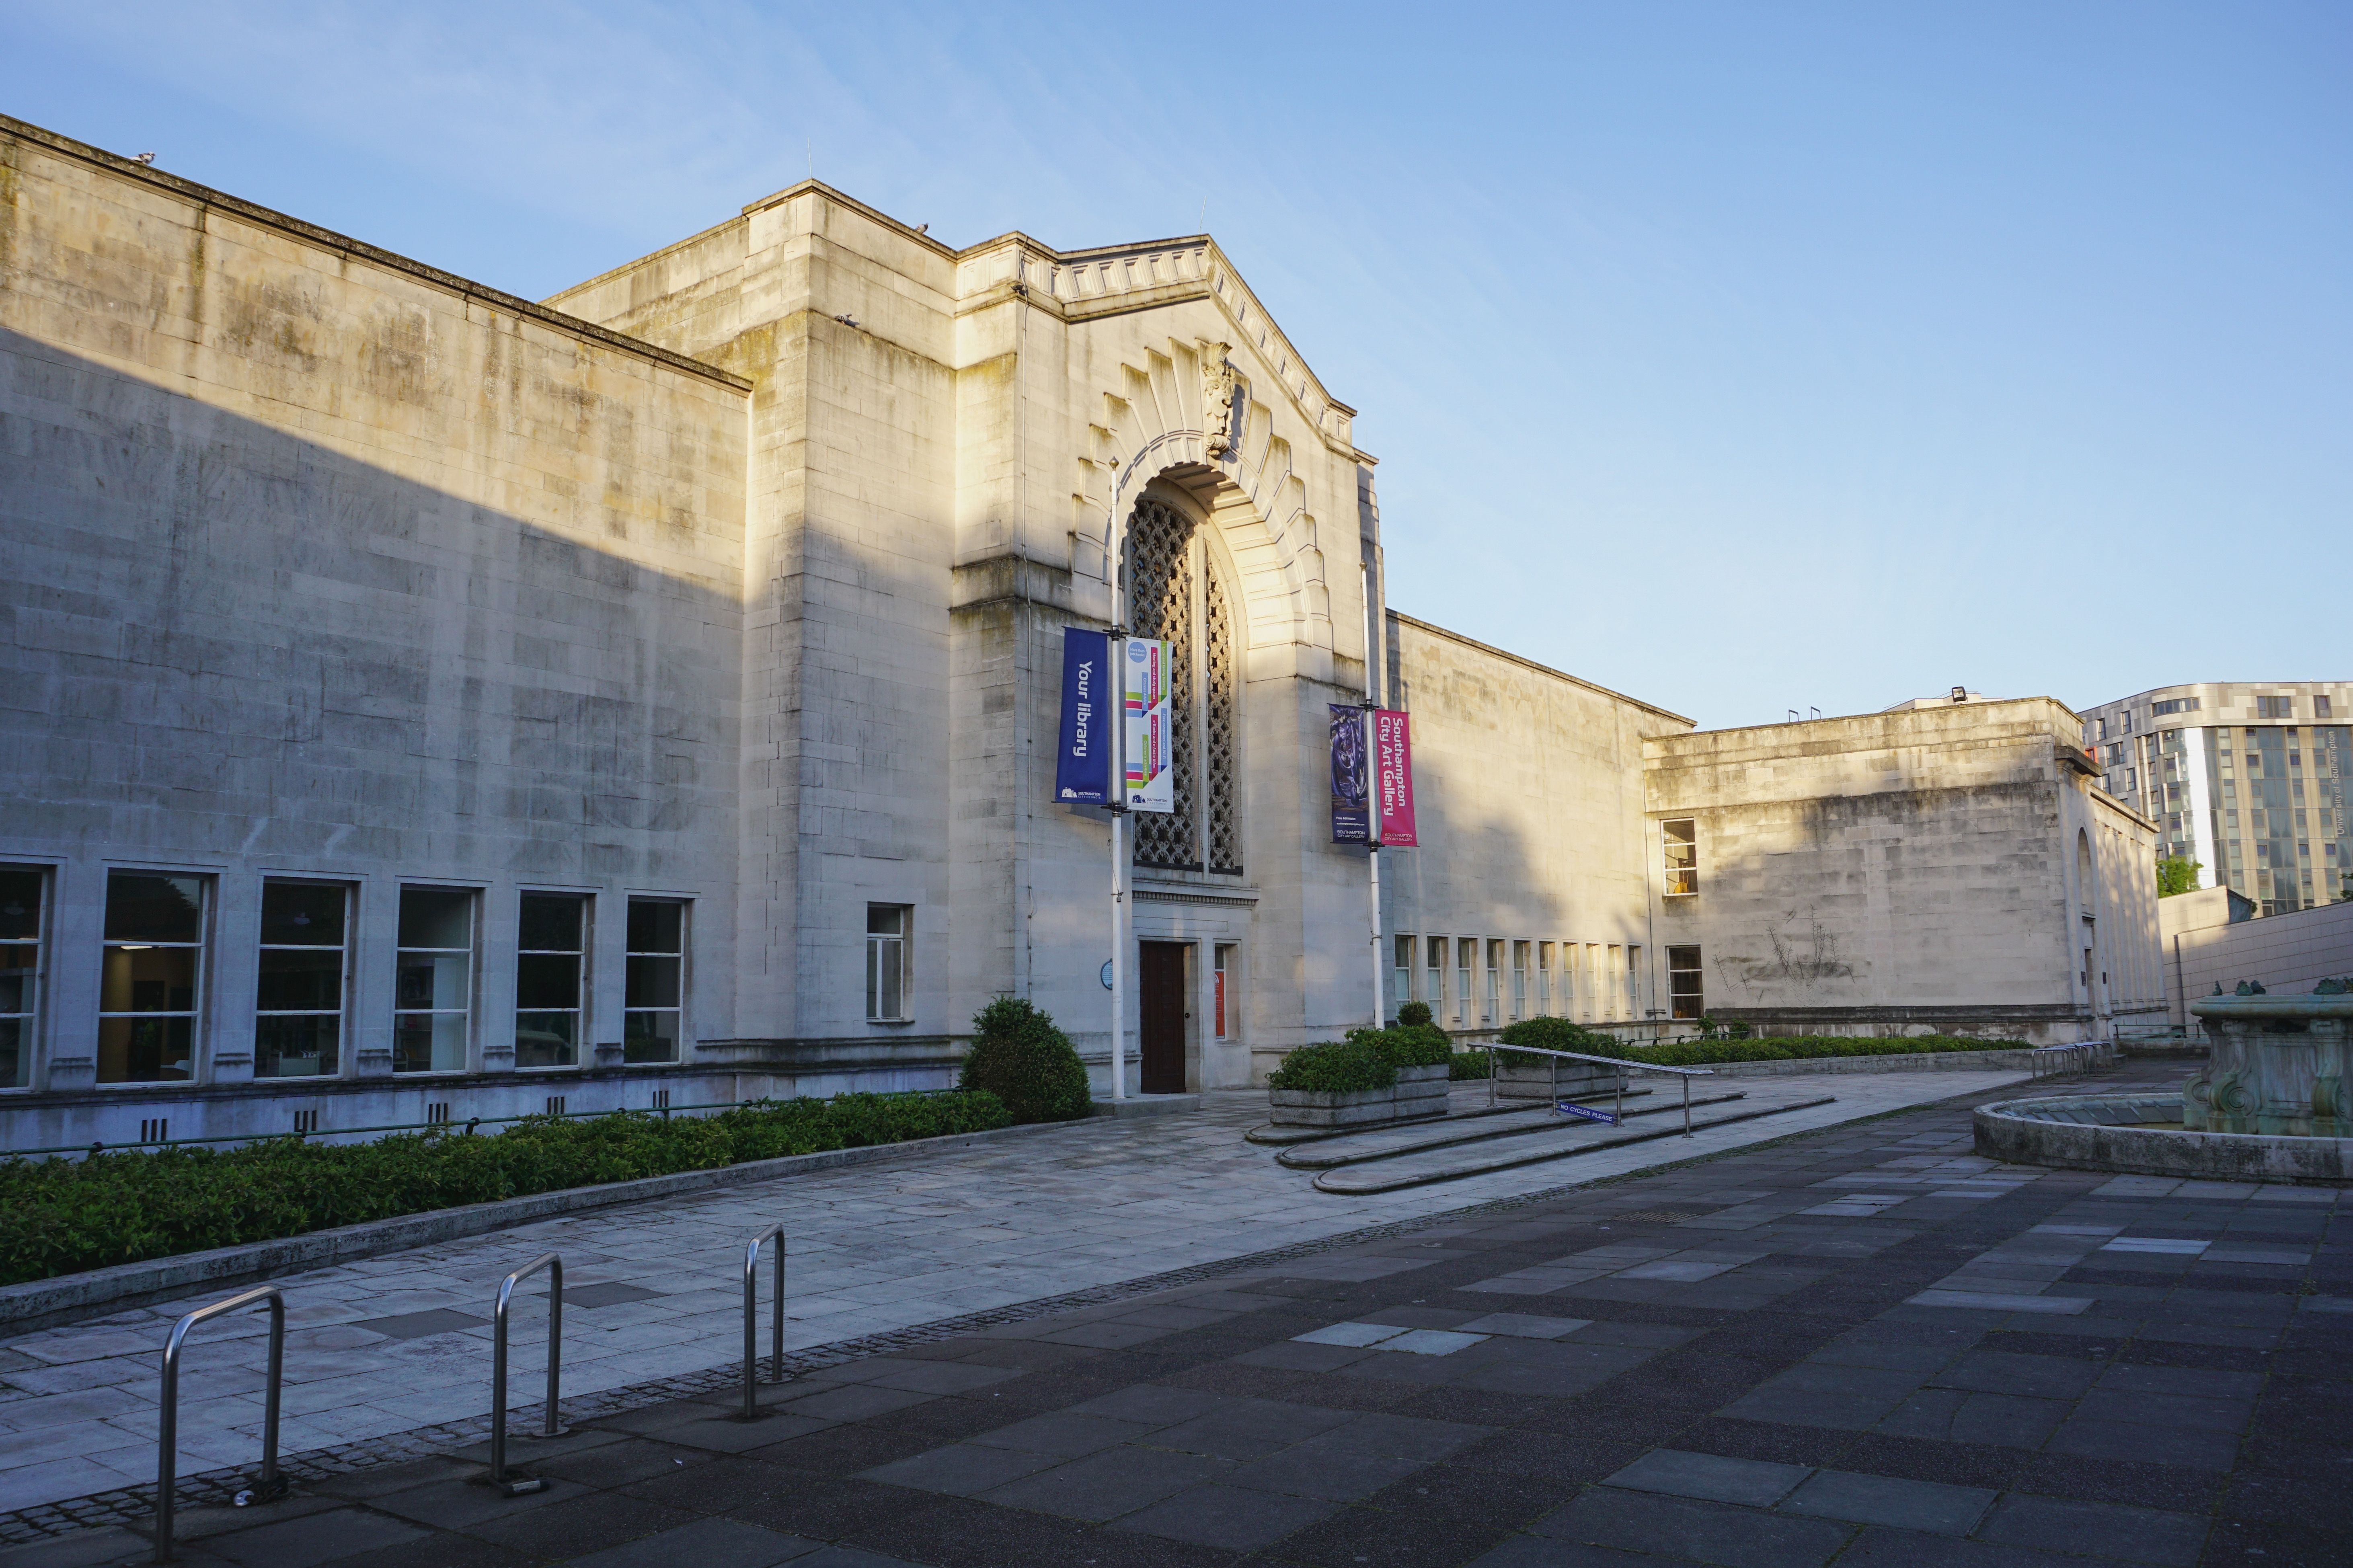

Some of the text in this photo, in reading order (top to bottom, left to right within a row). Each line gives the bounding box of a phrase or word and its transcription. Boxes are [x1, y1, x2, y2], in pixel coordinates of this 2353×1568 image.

[1073, 661, 1092, 757] Your library
[1379, 716, 1395, 816] City Art Gallery
[1393, 718, 1406, 806] Southampton
[2328, 731, 2339, 784] Southampton
[2334, 794, 2345, 834] University
[1570, 1106, 1590, 1116] CYCLES
[1592, 1112, 1613, 1122] PLEASE
